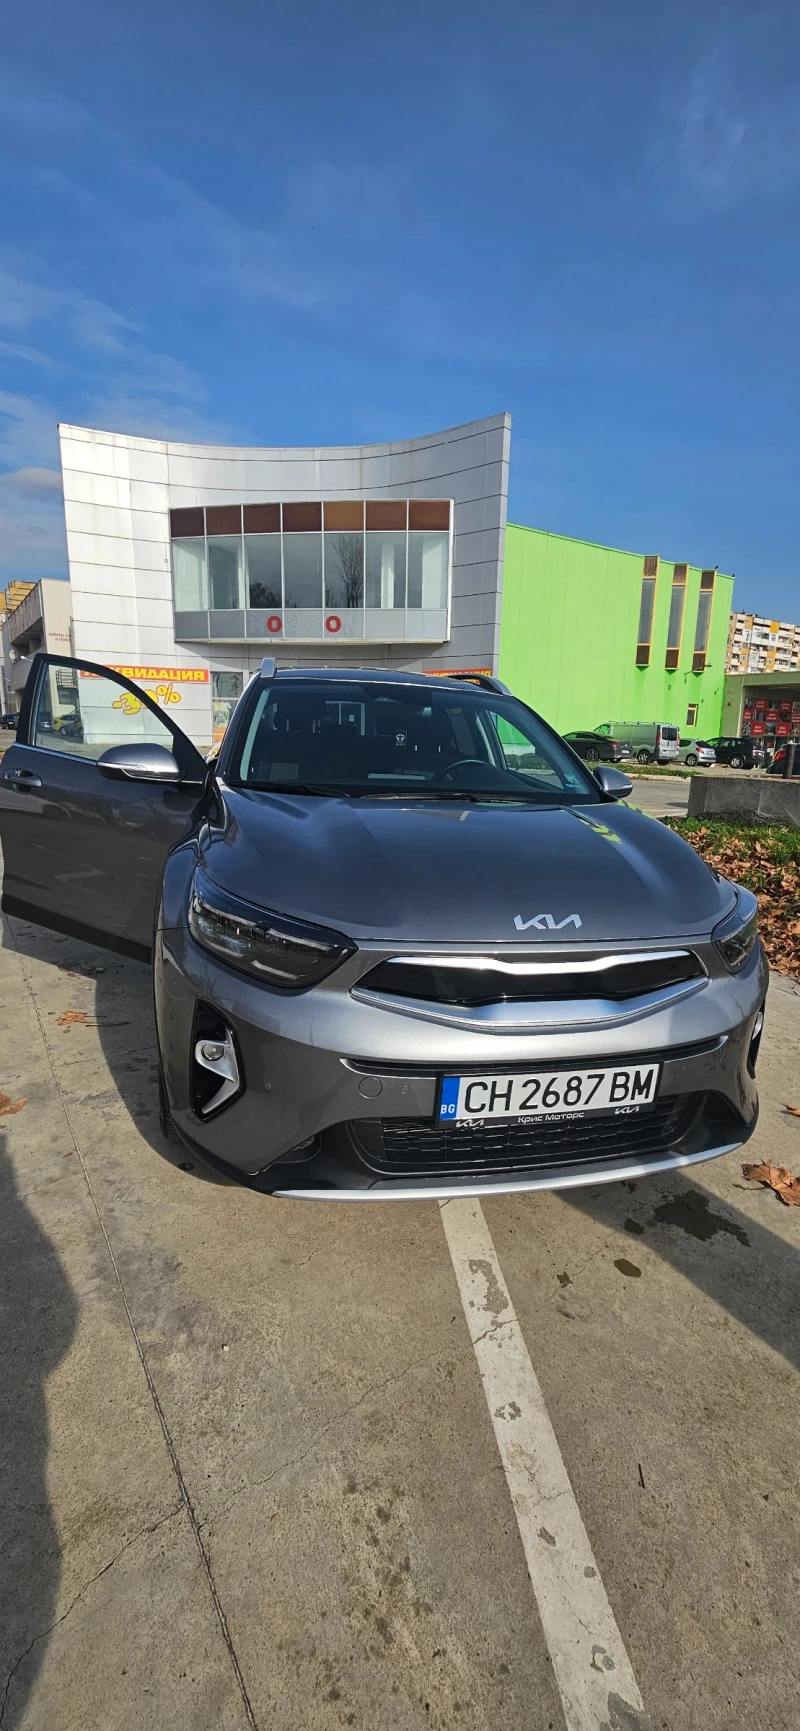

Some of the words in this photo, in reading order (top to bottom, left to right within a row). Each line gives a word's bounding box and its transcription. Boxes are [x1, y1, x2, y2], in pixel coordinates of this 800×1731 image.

[464, 1079, 514, 1114] CH
[518, 1073, 606, 1111] 2687
[608, 1068, 655, 1103] BM
[440, 1103, 456, 1115] BG
[517, 1115, 544, 1124] Крис
[544, 1112, 585, 1121] Моторс
